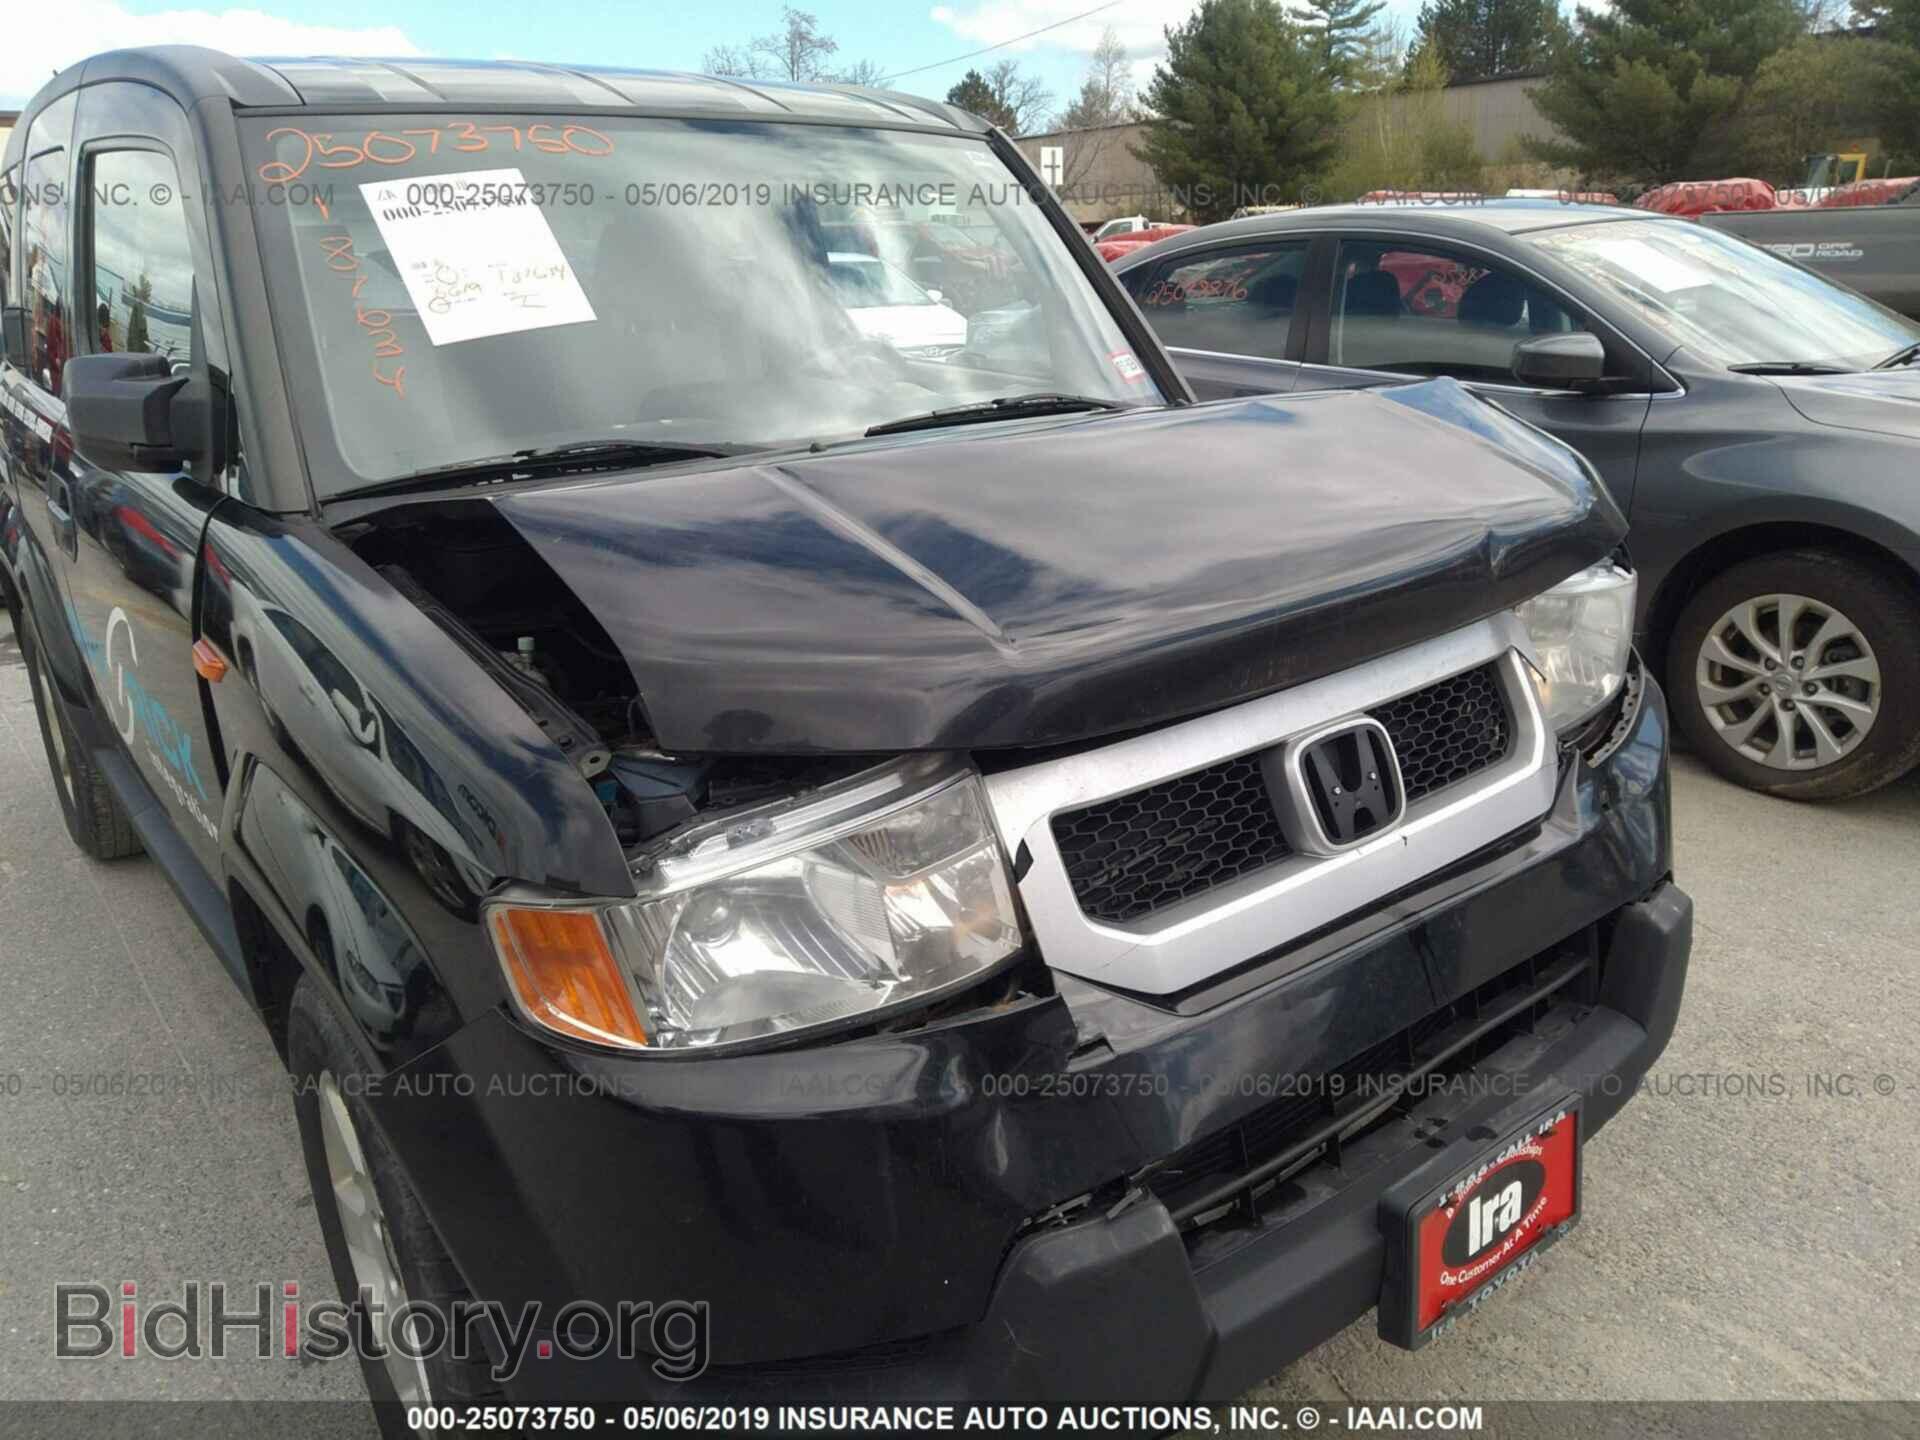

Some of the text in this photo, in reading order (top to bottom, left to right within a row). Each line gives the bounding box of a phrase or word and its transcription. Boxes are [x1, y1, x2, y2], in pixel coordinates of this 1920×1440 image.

[1816, 249, 1864, 257] ROAD
[1538, 1110, 1567, 1135] IRA
[1440, 1196, 1548, 1286] One Customer At A Time
[1469, 1180, 1523, 1257] Ira
[1468, 1248, 1539, 1307] TOYOTA
